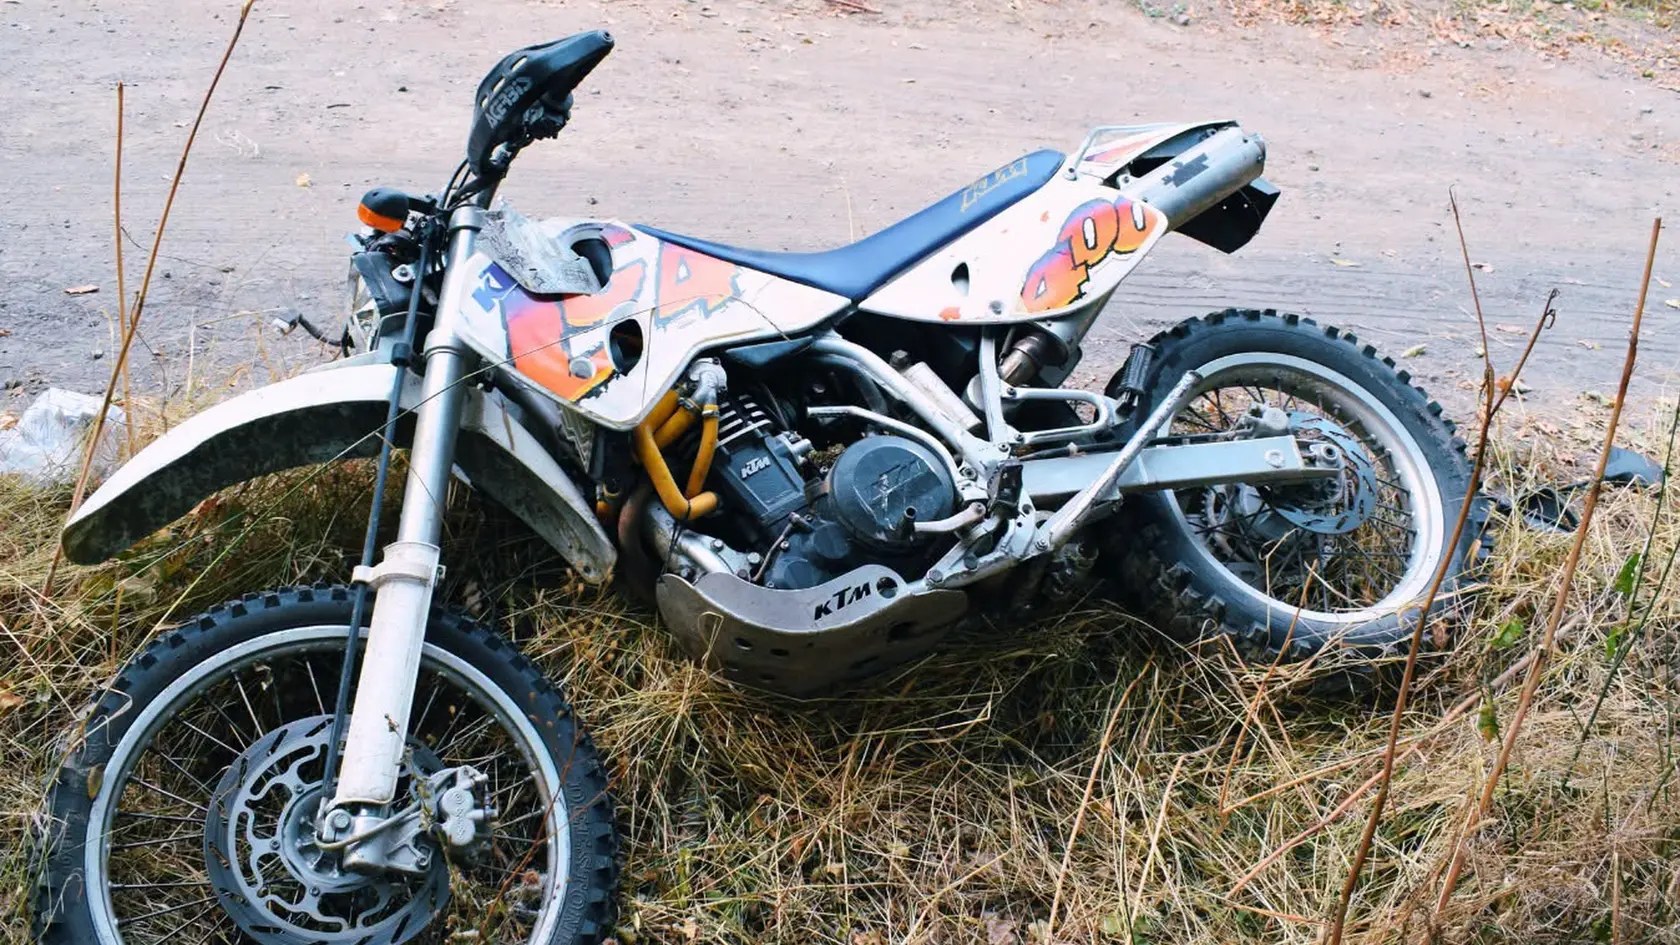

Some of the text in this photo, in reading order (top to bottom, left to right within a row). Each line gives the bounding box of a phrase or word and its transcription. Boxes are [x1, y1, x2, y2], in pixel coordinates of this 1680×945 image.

[1020, 194, 1159, 314] 400
[741, 455, 771, 480] KTM
[813, 581, 871, 621] KTM
